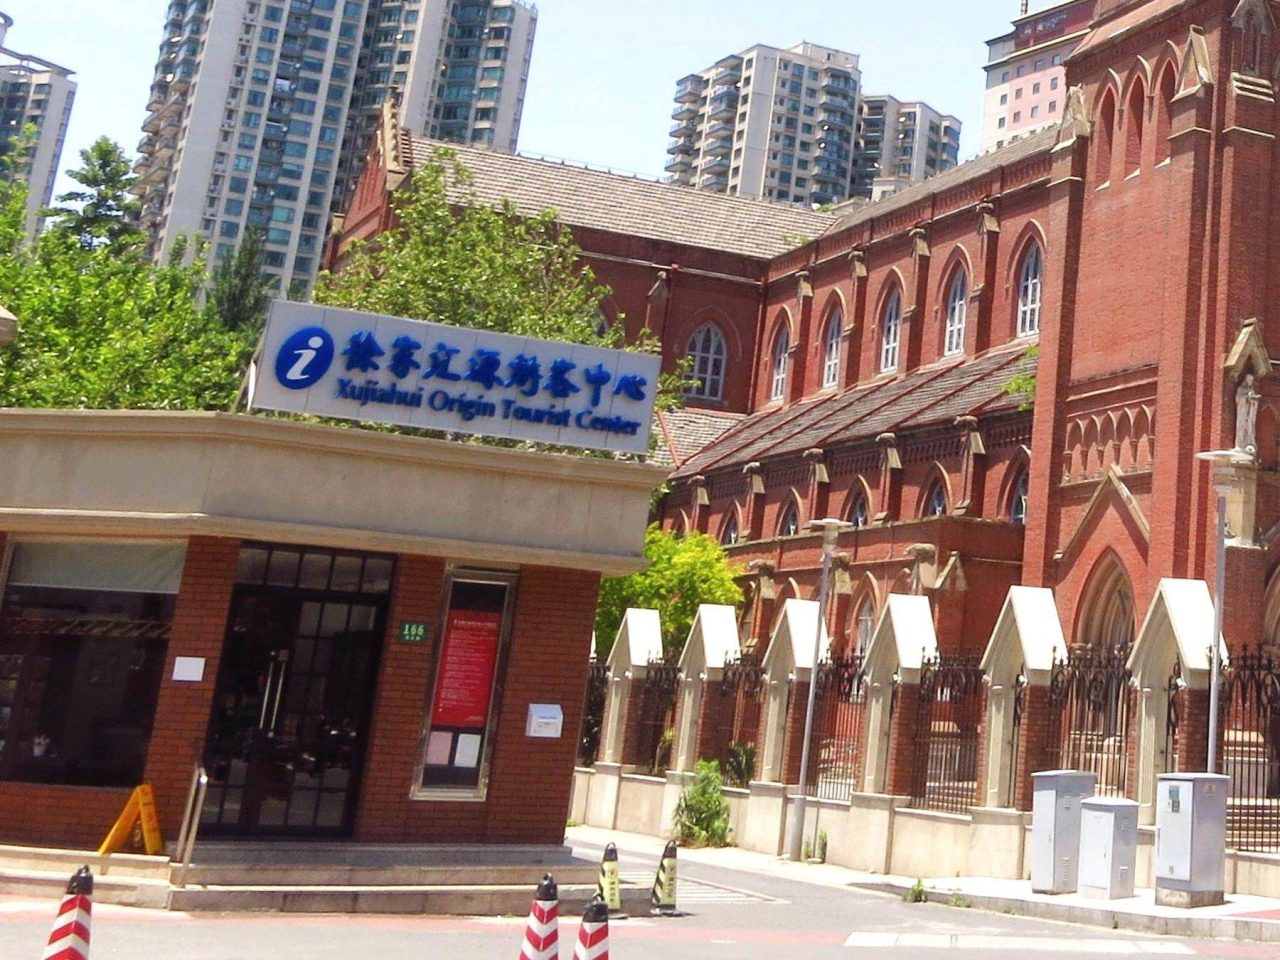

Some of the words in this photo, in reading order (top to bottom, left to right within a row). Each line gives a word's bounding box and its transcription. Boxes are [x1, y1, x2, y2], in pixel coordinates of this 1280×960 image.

[336, 377, 424, 408] Xujiahui
[428, 390, 496, 421] Origin
[502, 398, 571, 427] Tourist
[575, 409, 642, 435] Center
[403, 623, 424, 635] 166
